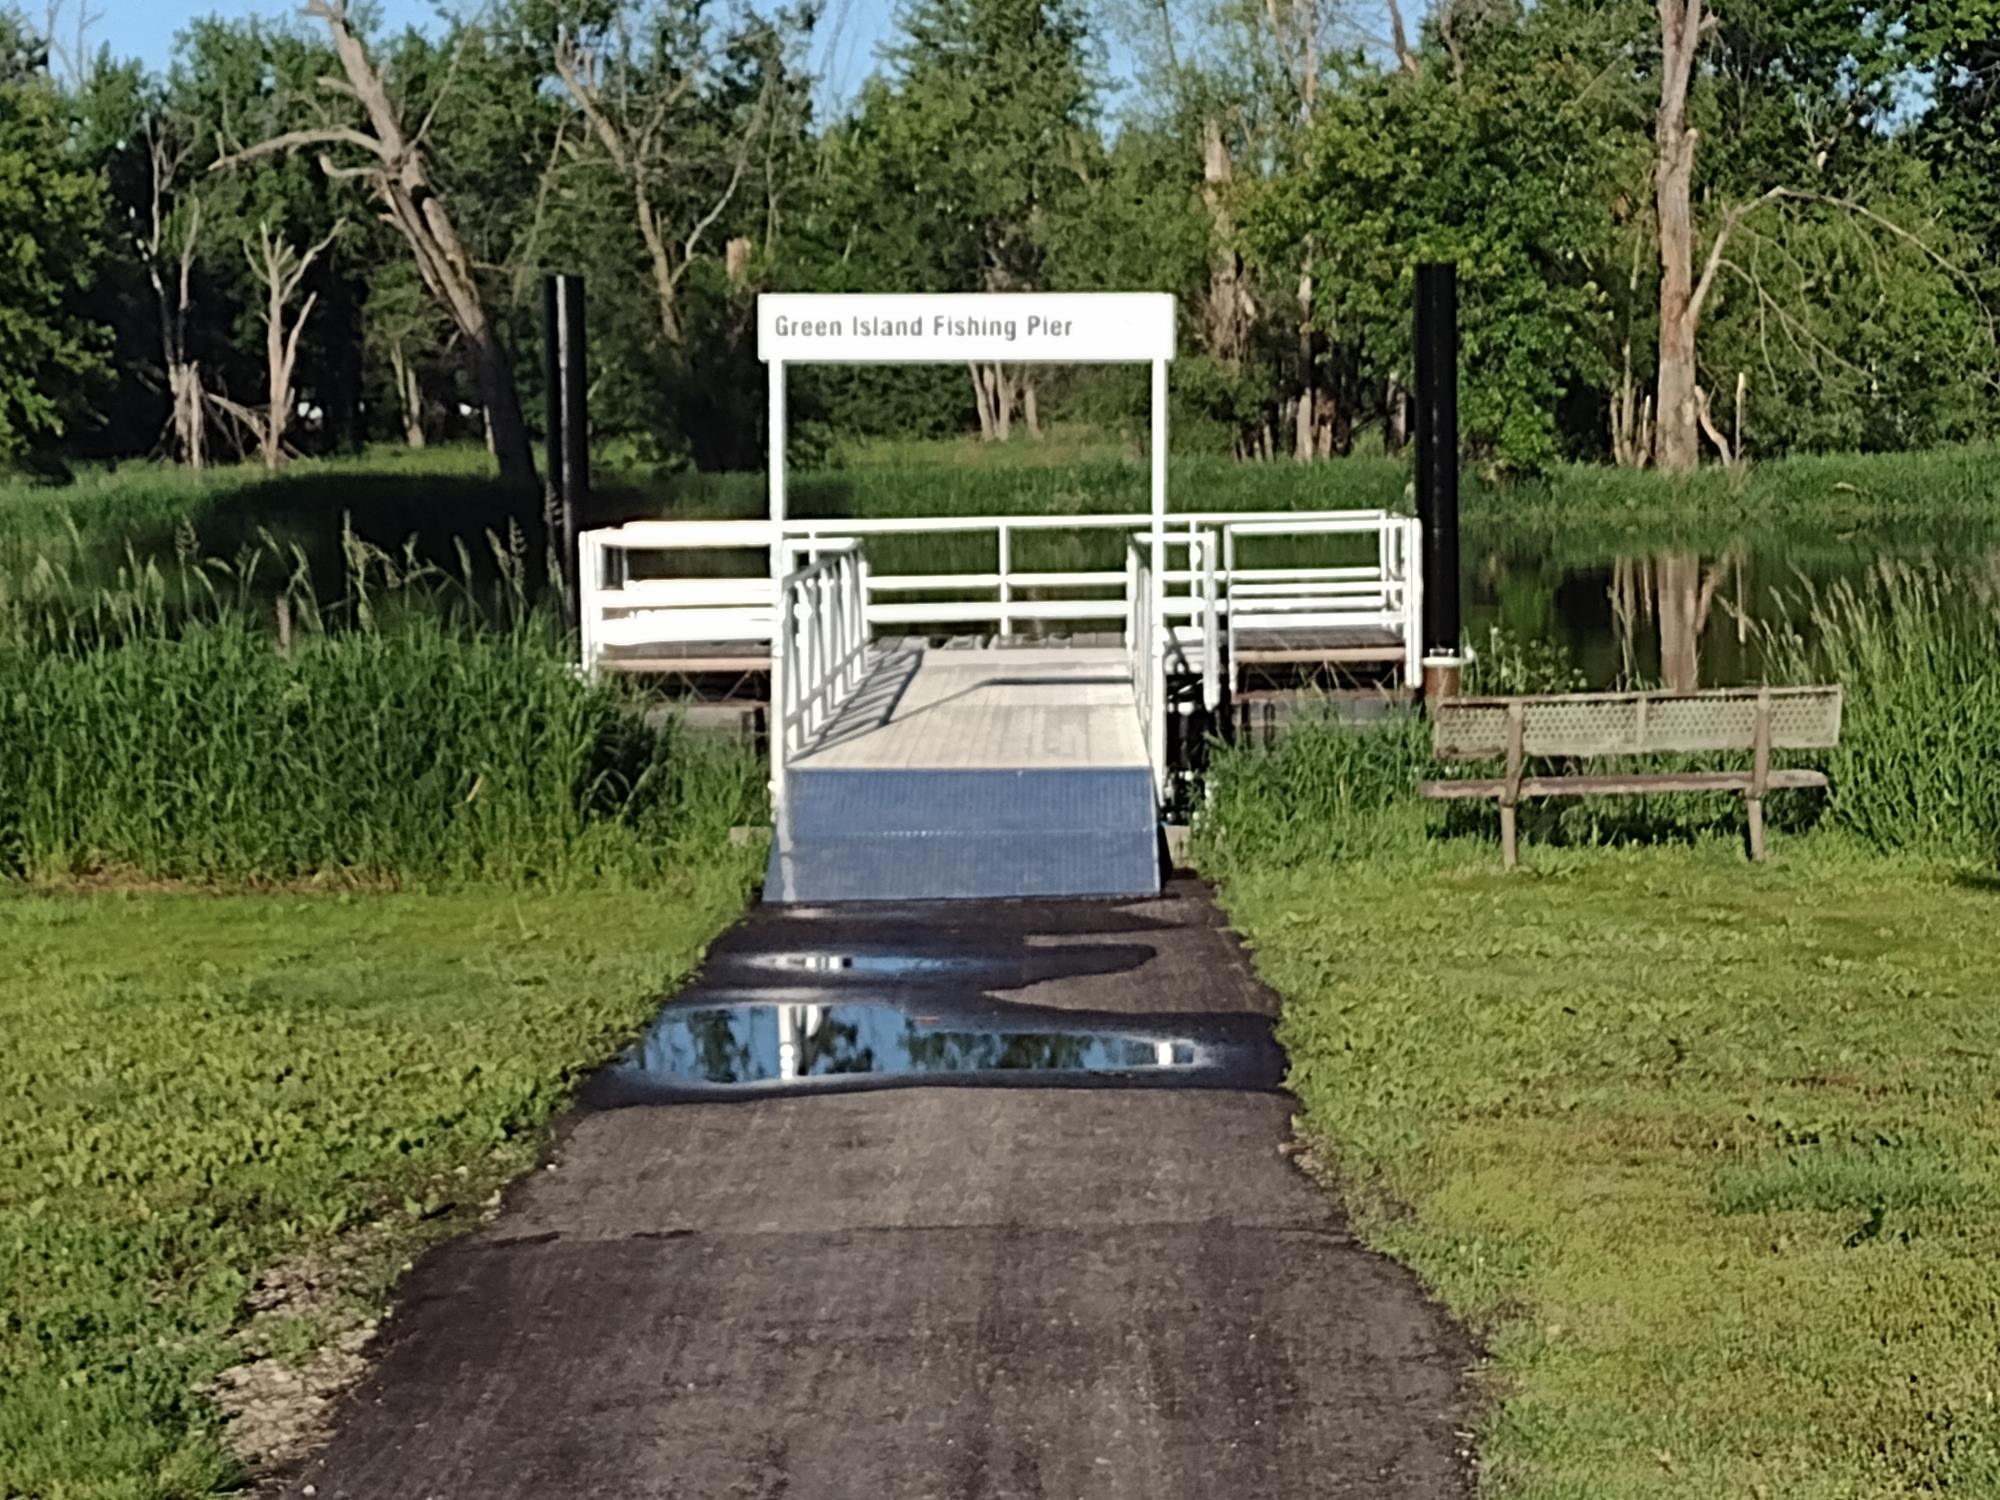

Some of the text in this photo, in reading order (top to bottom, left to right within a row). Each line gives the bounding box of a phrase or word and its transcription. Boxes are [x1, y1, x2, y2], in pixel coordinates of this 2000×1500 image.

[775, 315, 1073, 341] Green Island Fishing Pier
